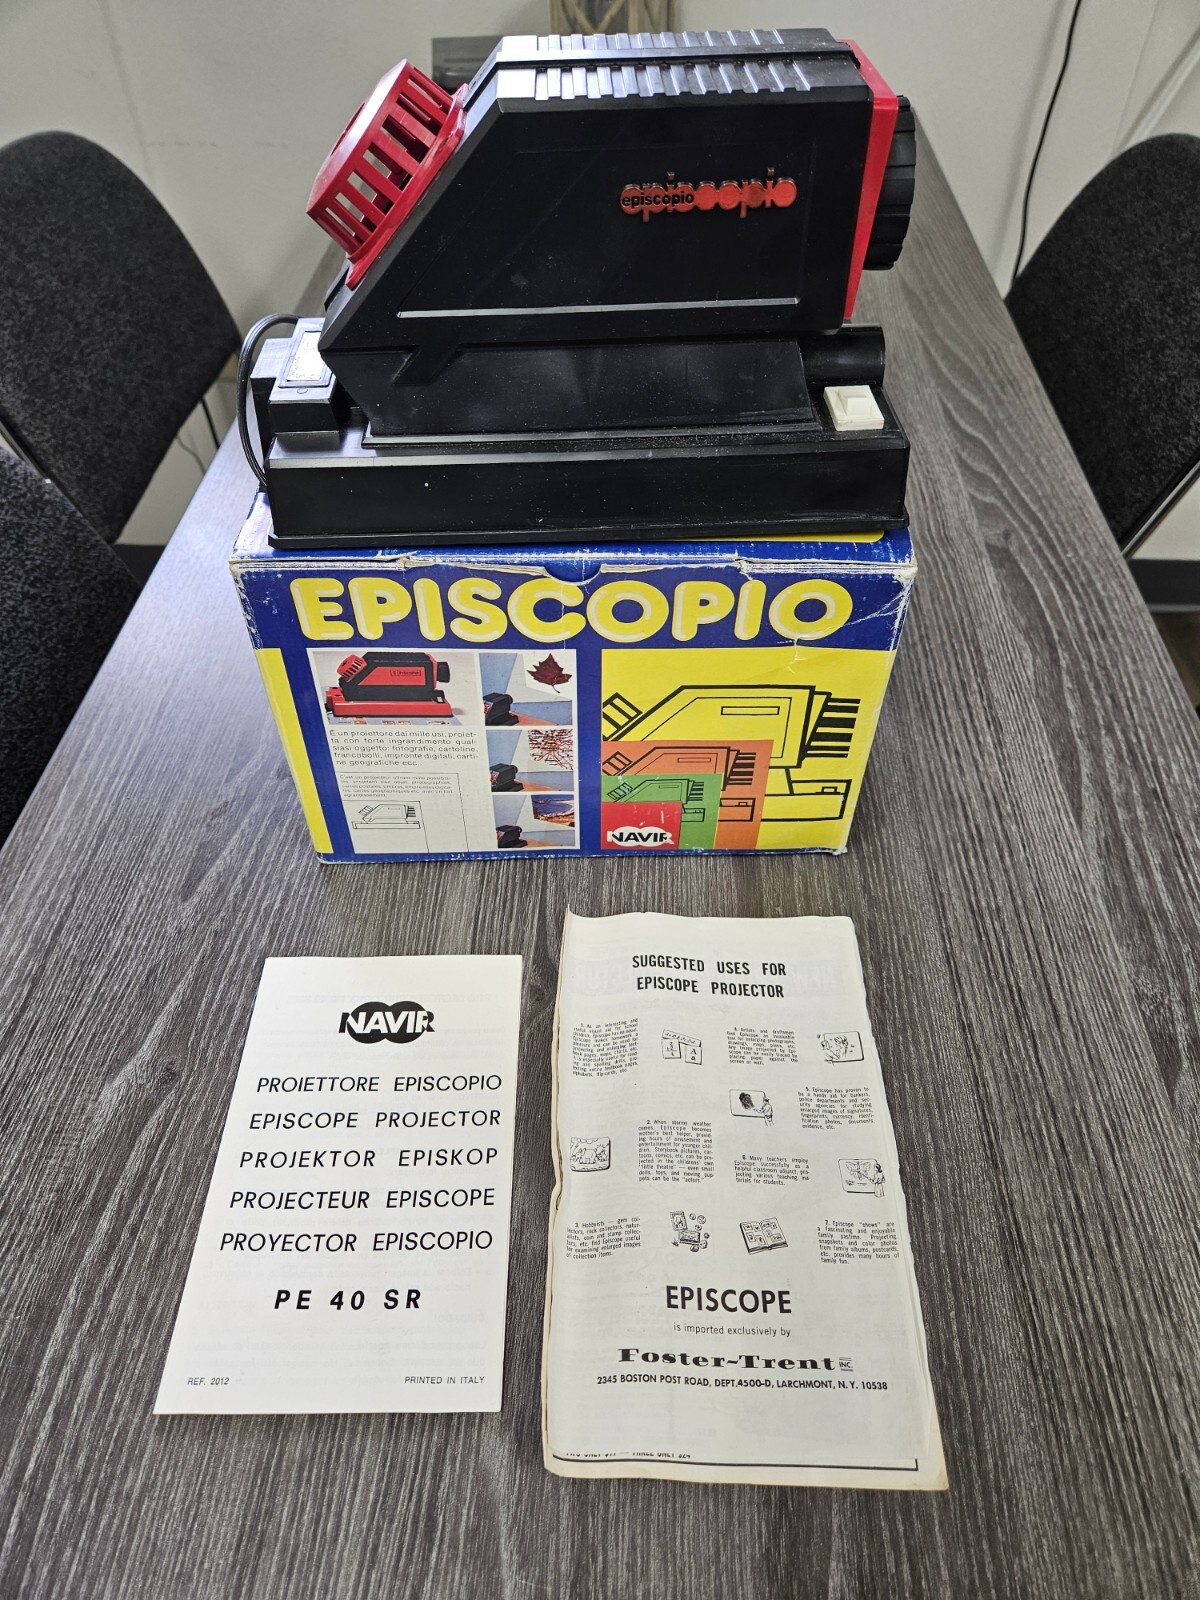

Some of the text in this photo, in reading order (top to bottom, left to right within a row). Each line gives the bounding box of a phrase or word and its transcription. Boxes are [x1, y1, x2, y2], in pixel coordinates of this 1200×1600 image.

[621, 191, 695, 208] episcopio
[290, 577, 853, 644] EPISCOPIO
[607, 830, 674, 845] NAVIR
[632, 954, 786, 976] SUGGESTED USES FOR
[636, 976, 785, 998] EPISCOPE PROJECTOR
[338, 1008, 436, 1036] NAVIR
[257, 1074, 502, 1092] PROIETTORE EPISCOPIO
[250, 1110, 501, 1130] EPISCOPE PROJECTOR
[240, 1148, 498, 1168] PROJEKTOR EPISKOP
[230, 1188, 496, 1209] PROJECTEUR EPISCOPE
[582, 1221, 605, 1229] Hobbyists
[220, 1230, 493, 1252] PROYECTOR EPISCOPIO
[274, 1289, 421, 1310] PE 40 SR
[665, 1285, 792, 1314] EPISCOPE
[674, 1322, 791, 1338] is imported exclusively by
[618, 1348, 836, 1371] Foster-Trent
[187, 1377, 230, 1386] REF. 2012
[404, 1376, 443, 1384] PRINTED
[460, 1376, 485, 1384] ITALY
[596, 1375, 618, 1384] 2345
[620, 1374, 657, 1383] BOSTON
[660, 1375, 681, 1384] POST
[684, 1377, 712, 1388] ROAD,
[776, 1380, 836, 1389] LARCHMONT,
[862, 1381, 888, 1390] 10538
